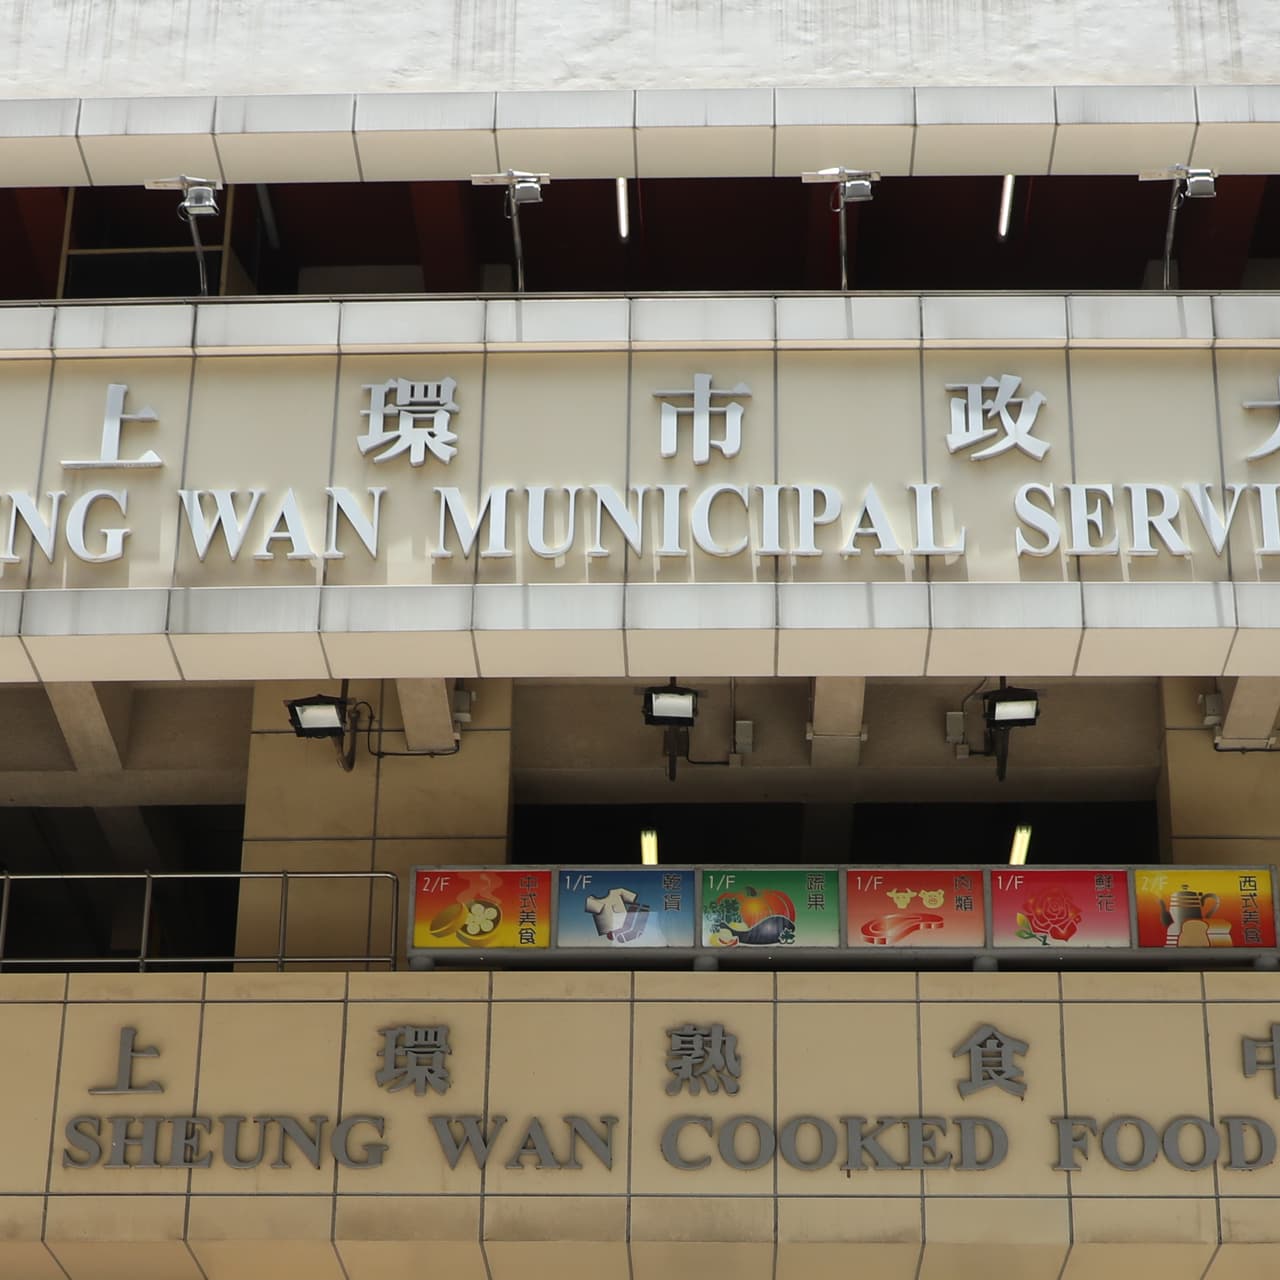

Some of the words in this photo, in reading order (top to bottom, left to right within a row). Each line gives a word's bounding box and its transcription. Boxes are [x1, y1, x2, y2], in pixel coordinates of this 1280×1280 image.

[180, 486, 386, 561] WAN
[431, 484, 965, 559] MUNICIPAL
[422, 876, 449, 892] 2/F
[565, 874, 592, 891] 1/F
[663, 873, 682, 912] 乾貨
[709, 874, 736, 890] 1/F
[806, 873, 826, 912] 蔬果
[856, 875, 883, 891] 1/F
[953, 874, 975, 912] 肉類
[997, 875, 1024, 890] 1/F
[1095, 873, 1116, 913] 鮮花
[61, 1114, 390, 1171] SHEUNG
[429, 1114, 620, 1171] WAN
[661, 1115, 1009, 1172] COOKED
[1051, 1115, 1278, 1172] FOOD
